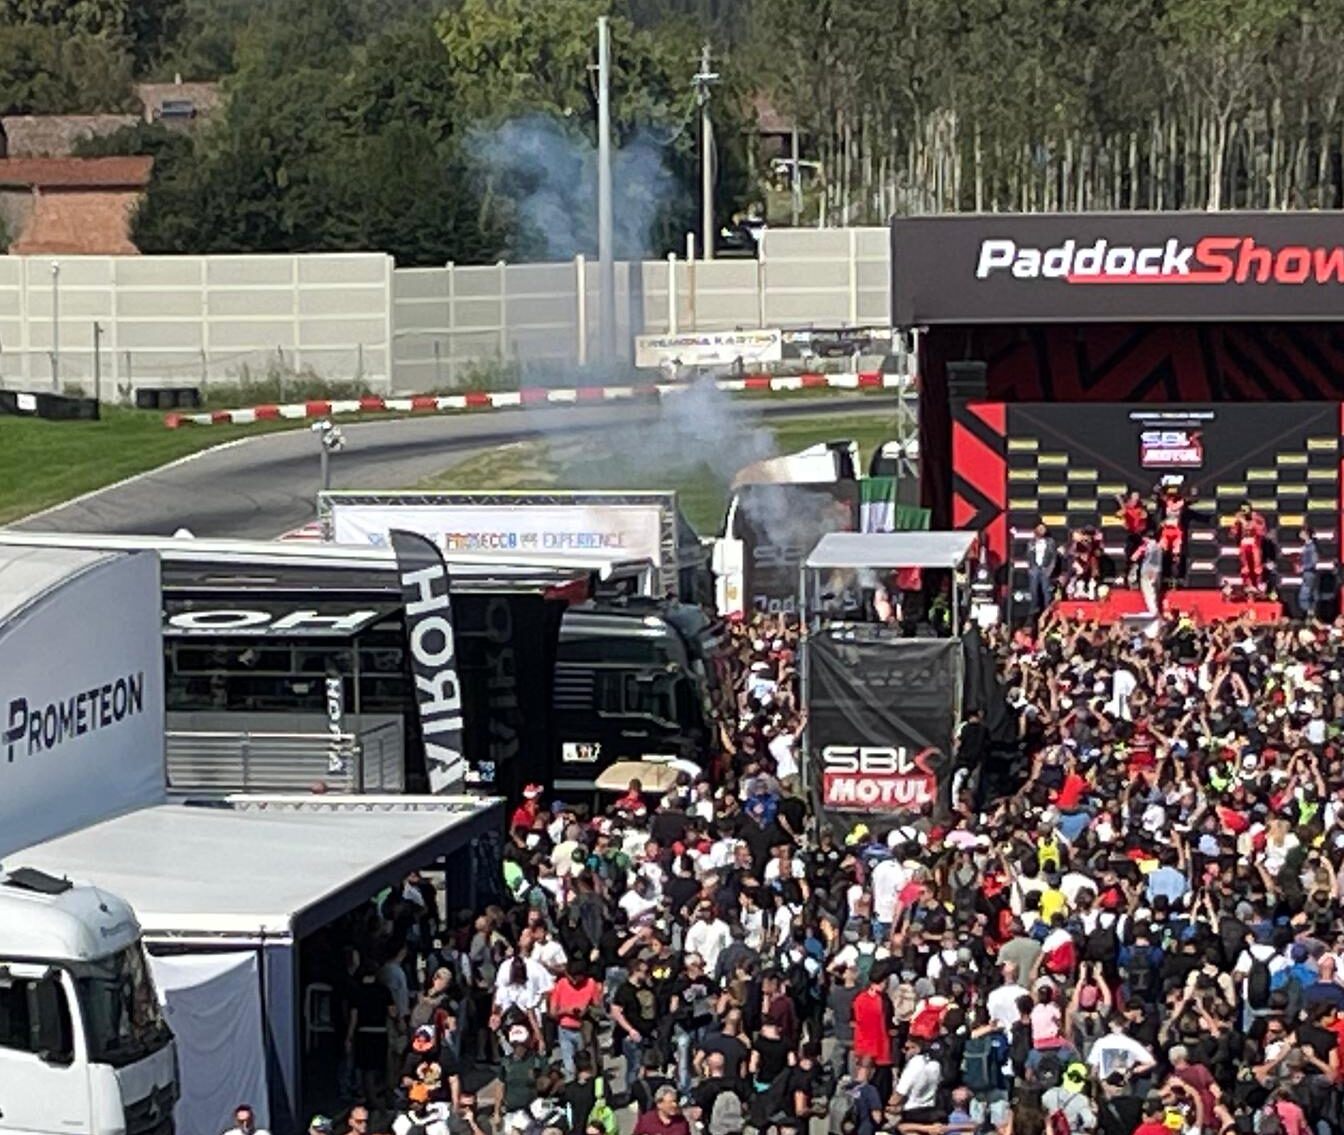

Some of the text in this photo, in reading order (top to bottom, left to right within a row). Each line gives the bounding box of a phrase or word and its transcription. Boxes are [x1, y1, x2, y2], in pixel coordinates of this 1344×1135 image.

[2, 670, 144, 763] PROMETEON
[822, 745, 941, 774] SBK
[828, 780, 933, 801] MOTUL
